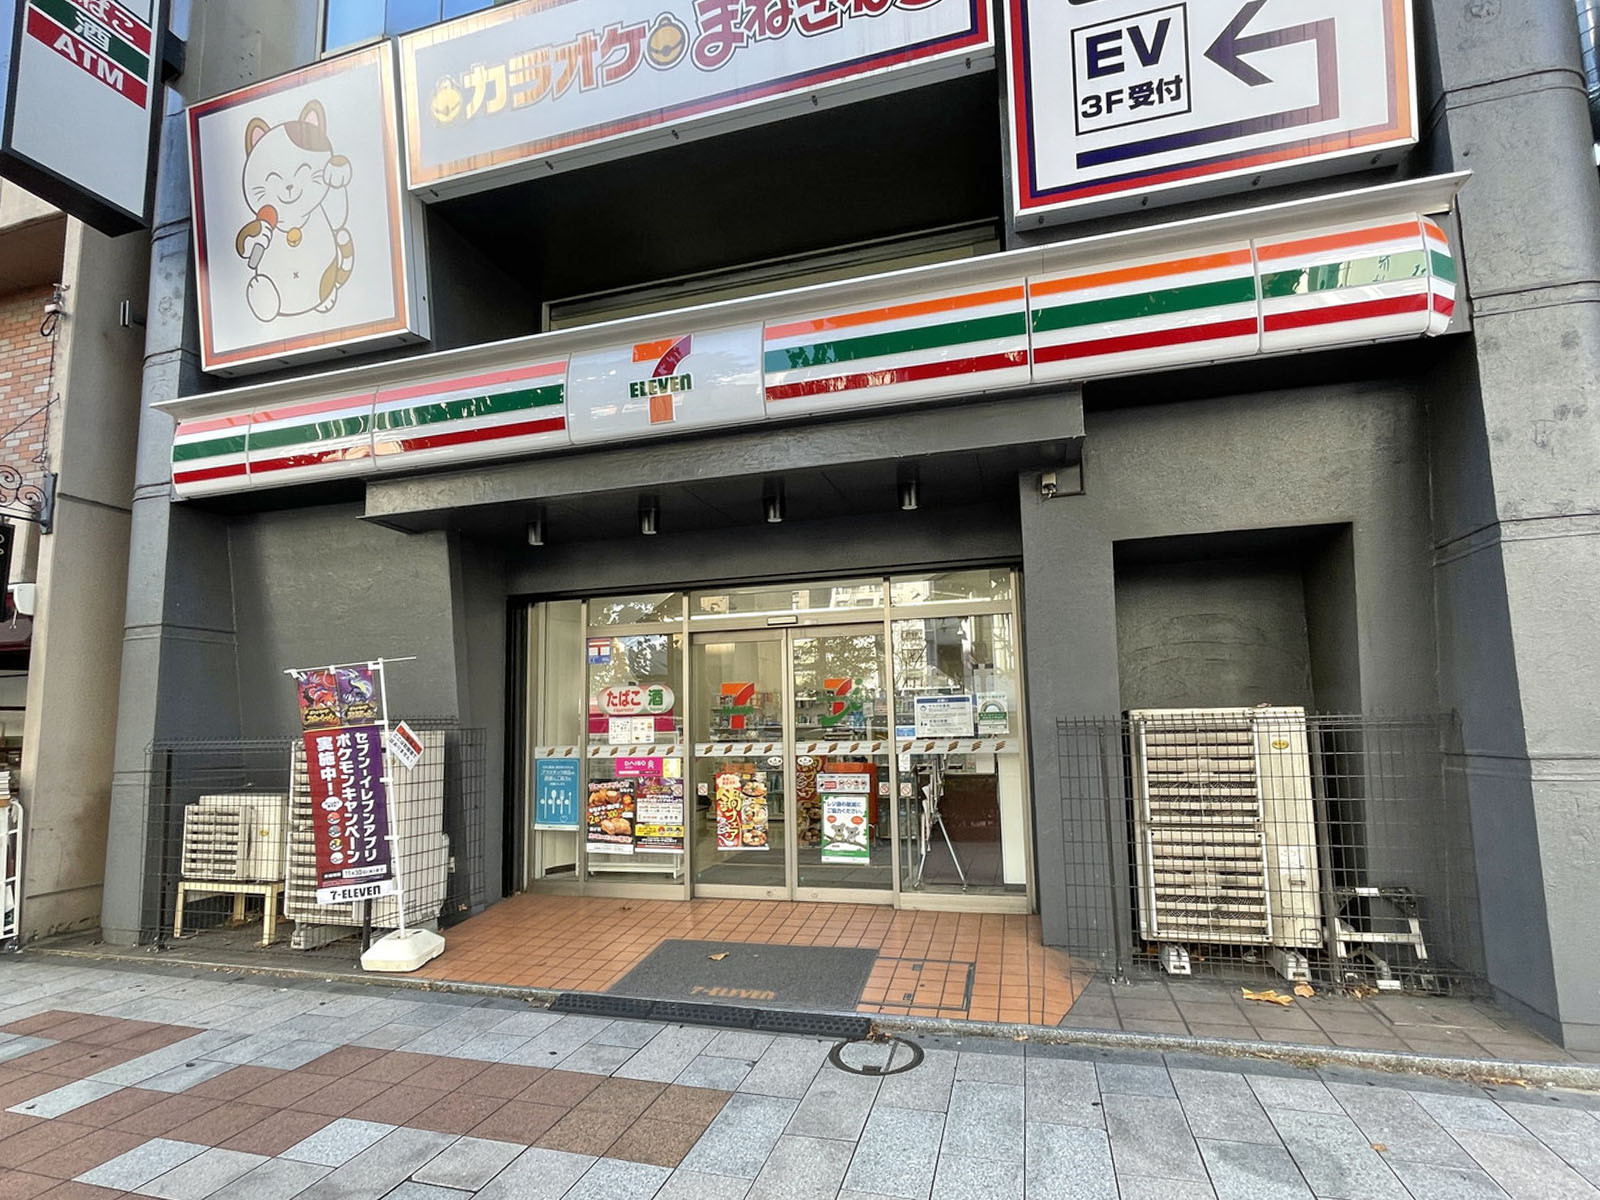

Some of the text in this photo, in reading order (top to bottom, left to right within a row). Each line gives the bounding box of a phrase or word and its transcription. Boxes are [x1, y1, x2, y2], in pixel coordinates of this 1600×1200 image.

[74, 10, 112, 53] 酒
[78, 0, 134, 41] ばこ
[53, 33, 124, 91] ATM
[461, 20, 648, 120] カラオケ
[1085, 17, 1172, 80] EV
[1080, 74, 1184, 119] 3F受付
[606, 689, 664, 707] たばこ 酒
[336, 732, 360, 864] ポケモンキャンペーン
